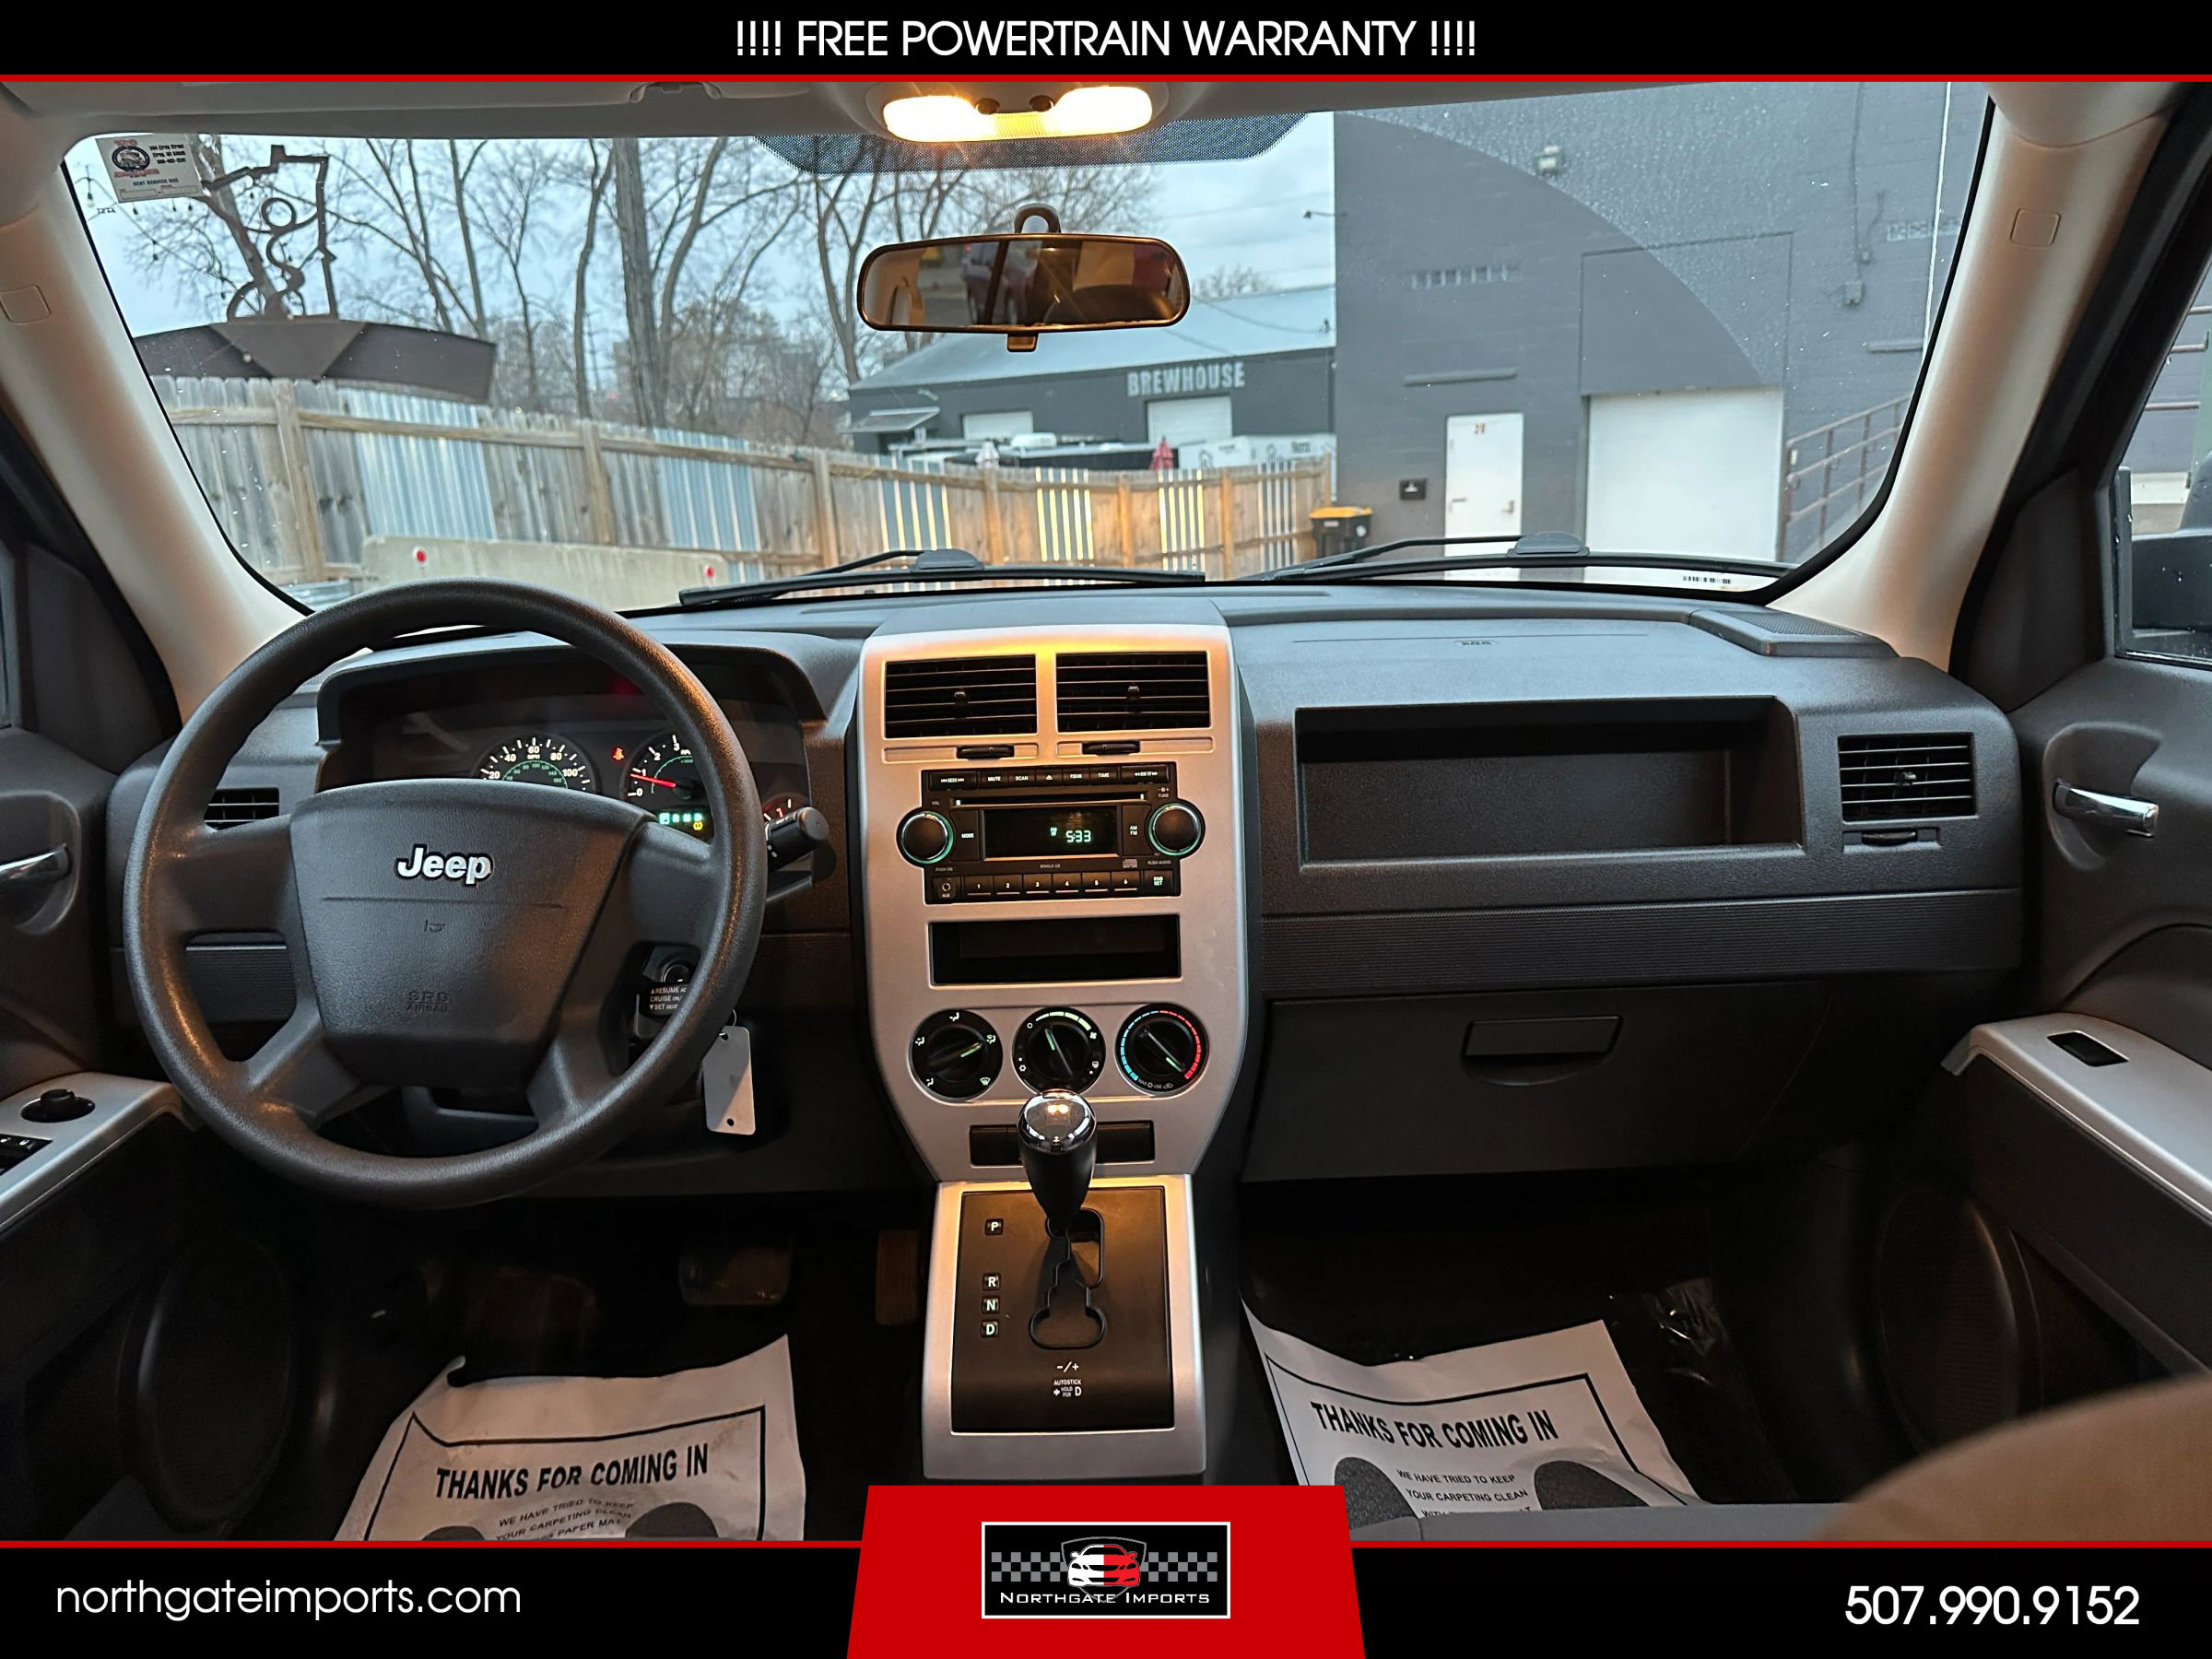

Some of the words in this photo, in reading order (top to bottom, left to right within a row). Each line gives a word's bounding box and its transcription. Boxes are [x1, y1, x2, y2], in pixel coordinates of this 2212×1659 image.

[1126, 361, 1245, 397] BREWHOUSE
[527, 746, 540, 754] 60
[674, 743, 680, 751] 3
[504, 753, 517, 762] 40
[653, 752, 661, 761] 2
[562, 769, 578, 777] 100
[1065, 830, 1091, 843] 5:33
[396, 845, 494, 886] Jeep
[991, 1221, 999, 1231] P
[988, 1276, 996, 1288] R
[986, 1300, 996, 1311] N
[985, 1324, 995, 1335] D
[1075, 1386, 1082, 1396] D
[1310, 1401, 1395, 1444] THANKS
[1394, 1420, 1443, 1448] FOR
[1441, 1414, 1528, 1448] COMING
[1527, 1409, 1559, 1441] IN
[436, 1467, 529, 1500] THANKS
[536, 1465, 582, 1493] FOR
[590, 1449, 677, 1488] COMING
[687, 1443, 709, 1477] IN
[1396, 1468, 1414, 1480] WE
[1414, 1473, 1441, 1483] HAVE
[1441, 1475, 1472, 1484] TRIED
[1475, 1475, 1488, 1484] TO
[1490, 1475, 1515, 1484] KEEP
[1406, 1488, 1433, 1500] YOUR
[1436, 1492, 1492, 1502] CARPETING
[1495, 1489, 1529, 1502] CLEAN
[499, 1517, 517, 1527] WE
[520, 1507, 549, 1522] HAVE
[553, 1499, 583, 1512] TRIED
[606, 1500, 634, 1509] KEEP
[496, 1527, 526, 1540] YOUR
[529, 1509, 592, 1532] CARPETING
[595, 1509, 632, 1519] CLEAN
[558, 1521, 594, 1535] PAPER
